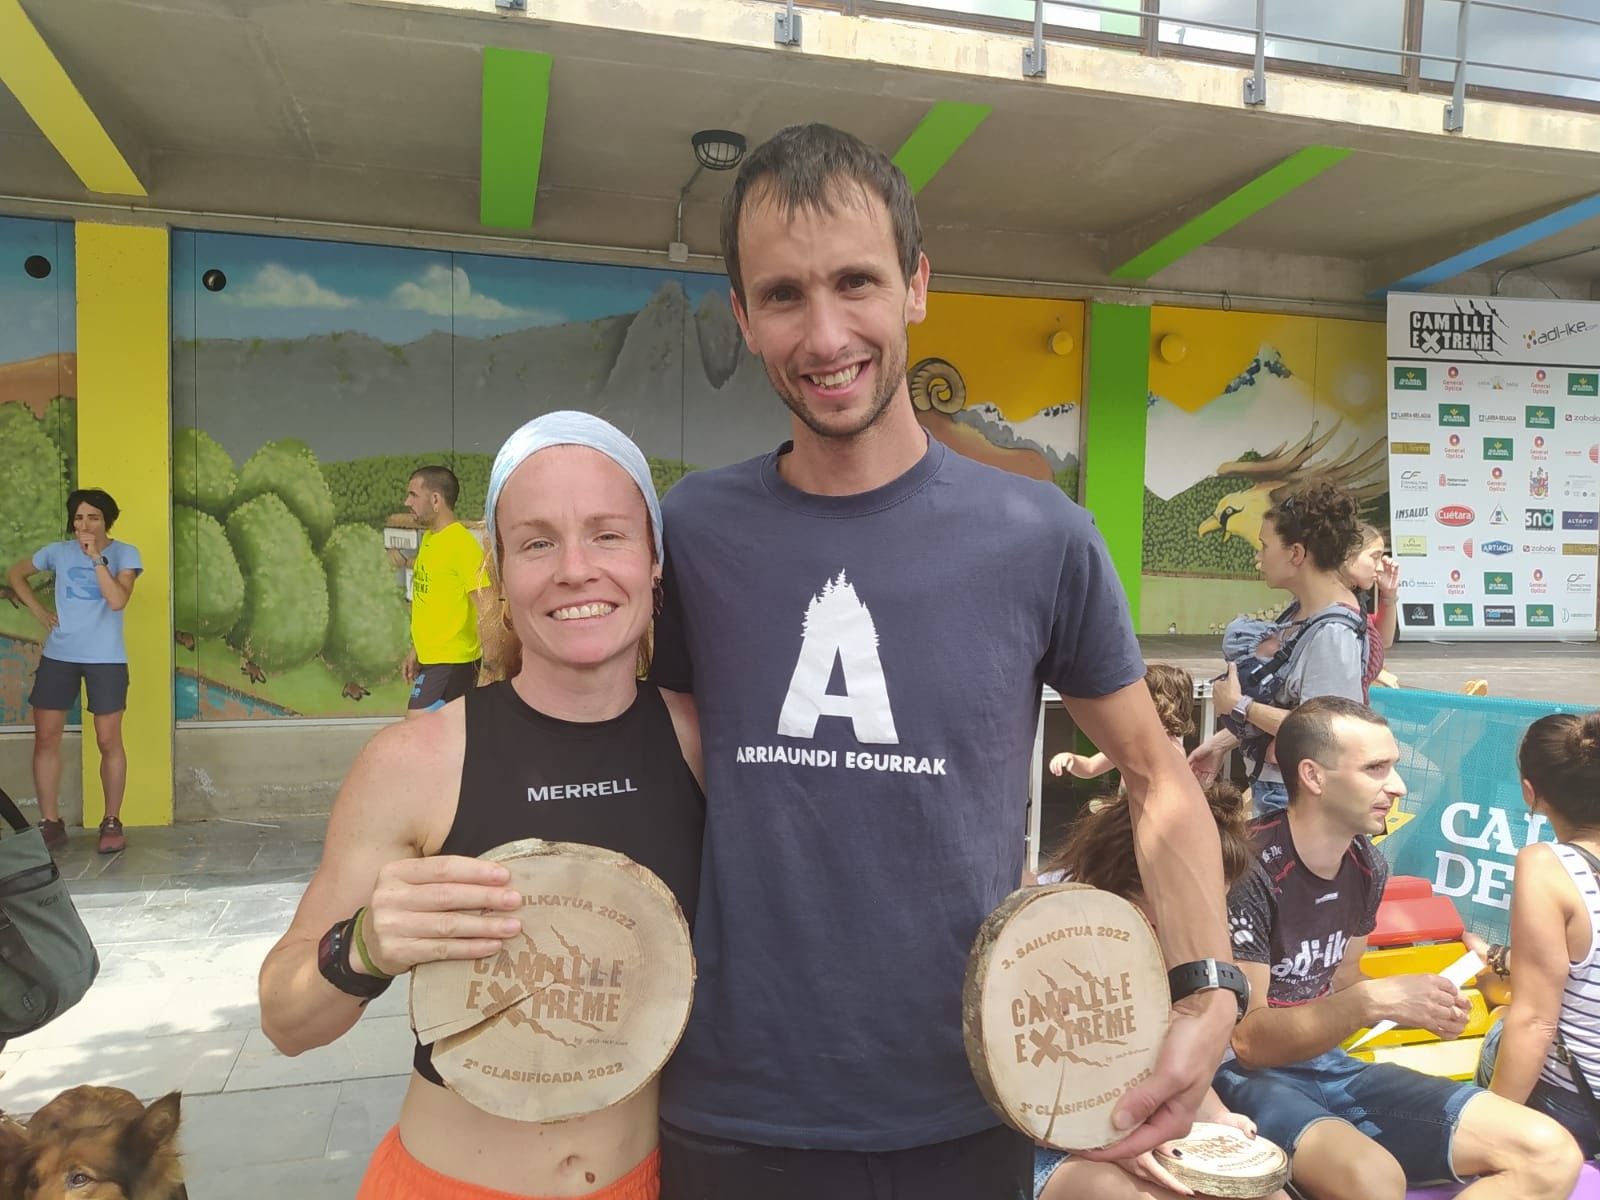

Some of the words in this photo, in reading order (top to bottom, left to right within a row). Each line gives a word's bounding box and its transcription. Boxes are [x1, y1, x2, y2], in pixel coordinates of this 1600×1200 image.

[1412, 312, 1491, 333] CAMILLE
[1412, 330, 1491, 353] EXTREME
[1395, 507, 1429, 519] INSALUS
[1438, 510, 1472, 520] Cuétara
[777, 568, 900, 745] A
[736, 746, 838, 768] ARRIAUNDI
[845, 752, 947, 775] EGURRAK
[527, 778, 638, 802] MERRELL
[1431, 850, 1515, 910] DE
[521, 894, 594, 912] ILKATUA
[598, 906, 637, 930] 2022
[1016, 926, 1093, 959] SAILKATUA
[1097, 926, 1131, 942] 2022
[465, 979, 622, 1028] EXTREME
[1014, 1004, 1137, 1067] EXTREME
[481, 1064, 584, 1084] CLASIFICADA
[587, 1062, 625, 1079] 2022
[1035, 1088, 1121, 1116] CLASIFICADO
